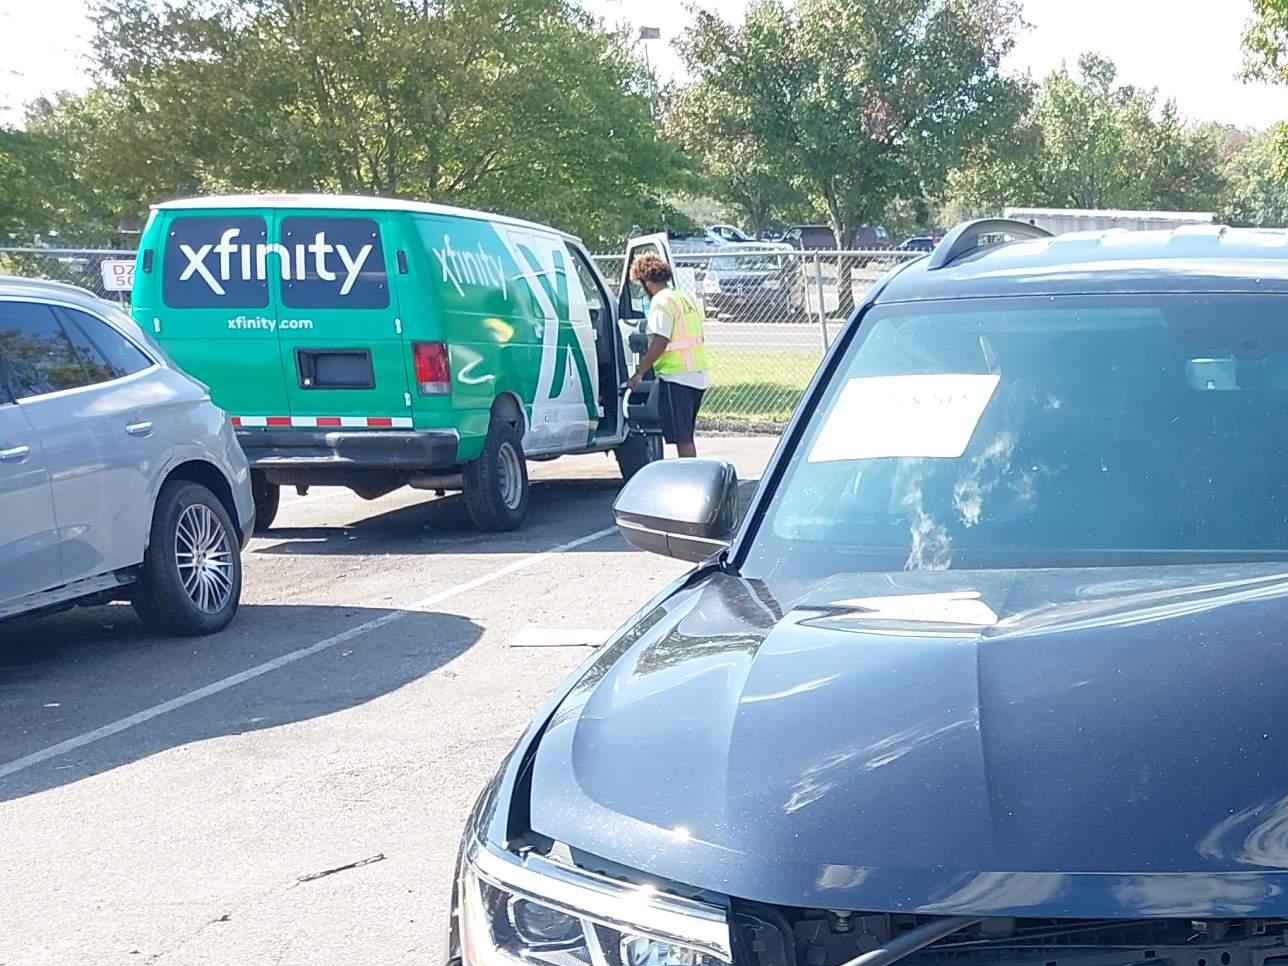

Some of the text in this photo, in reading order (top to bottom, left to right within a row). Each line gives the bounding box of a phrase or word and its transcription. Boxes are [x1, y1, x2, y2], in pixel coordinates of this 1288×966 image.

[179, 228, 372, 295] xfinity
[432, 234, 507, 300] xfinity
[227, 316, 314, 332] xfinity.com
